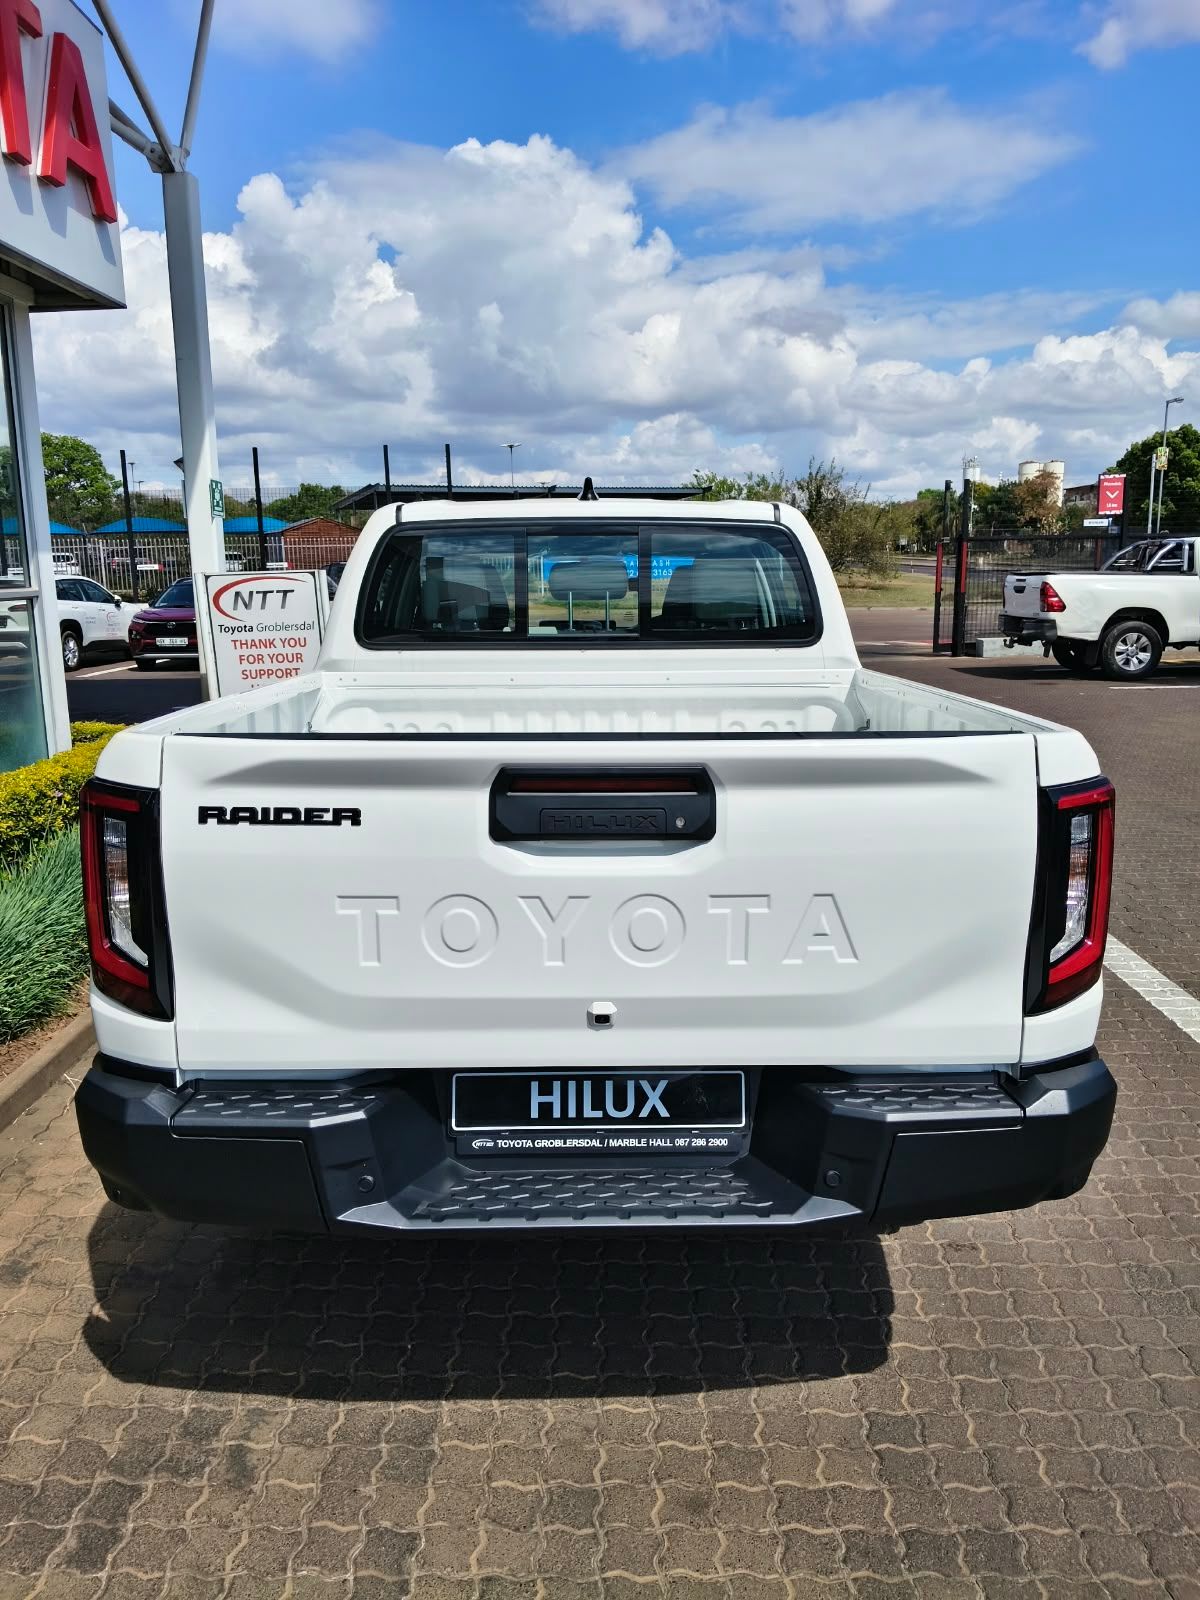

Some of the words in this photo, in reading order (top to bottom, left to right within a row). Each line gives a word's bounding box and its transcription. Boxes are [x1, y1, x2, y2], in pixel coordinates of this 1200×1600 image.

[233, 589, 294, 611] NTT
[218, 624, 254, 635] Toyota
[256, 620, 315, 632] Groblersdal
[231, 638, 277, 650] THANK
[279, 637, 307, 649] YOU
[239, 654, 265, 665] FOR
[267, 652, 304, 664] YOUR
[241, 667, 301, 680] SUPPORT
[198, 806, 362, 826] RAIDER
[547, 815, 659, 829] HILUX
[335, 893, 860, 968] TOYOTA
[530, 1080, 671, 1118] HILUX
[497, 1139, 533, 1148] TOYOTA
[535, 1139, 603, 1148] GROBLERSDAL
[604, 1138, 608, 1147] /
[609, 1138, 648, 1147] MARBLE
[649, 1138, 674, 1147] HALL
[675, 1138, 690, 1147] 087
[691, 1138, 706, 1147] 286
[708, 1138, 729, 1147] 2900
